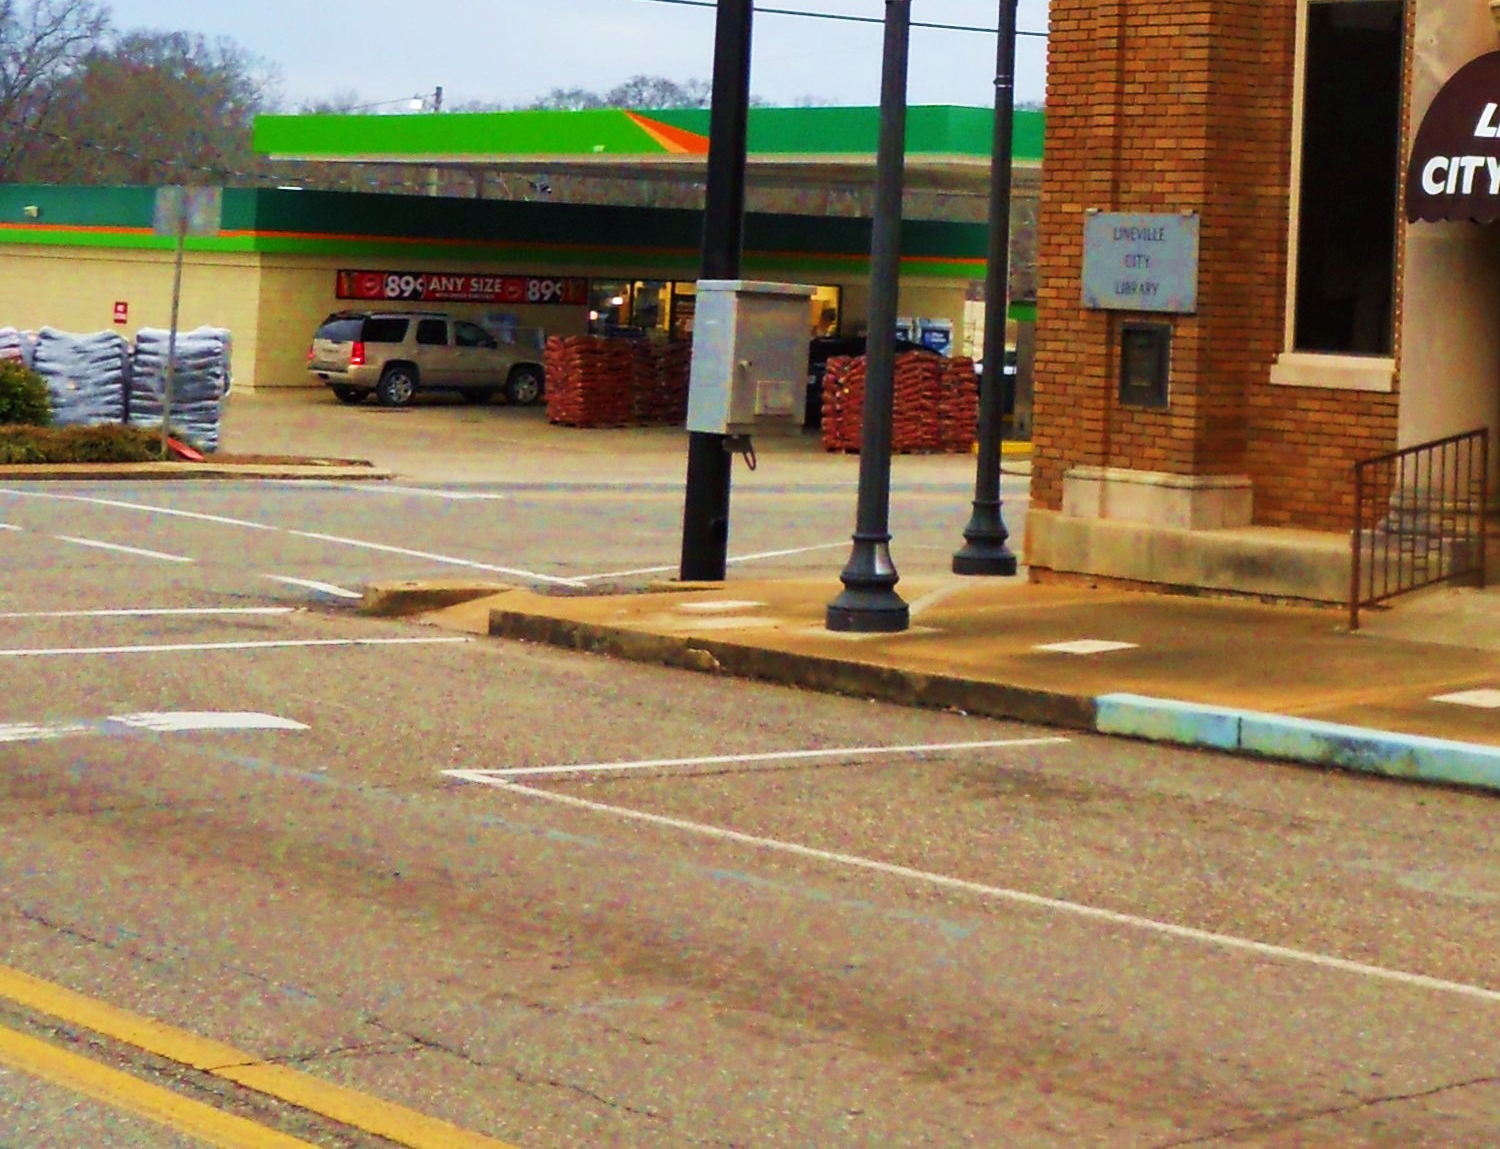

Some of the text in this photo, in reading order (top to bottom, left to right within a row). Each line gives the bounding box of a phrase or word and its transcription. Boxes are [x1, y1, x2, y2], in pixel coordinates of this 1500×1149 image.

[1113, 226, 1165, 242] LINEVILLE
[1125, 254, 1150, 269] CITY
[429, 277, 463, 292] ANY
[470, 278, 503, 293] SIZE
[1115, 281, 1159, 297] LIBRARY
